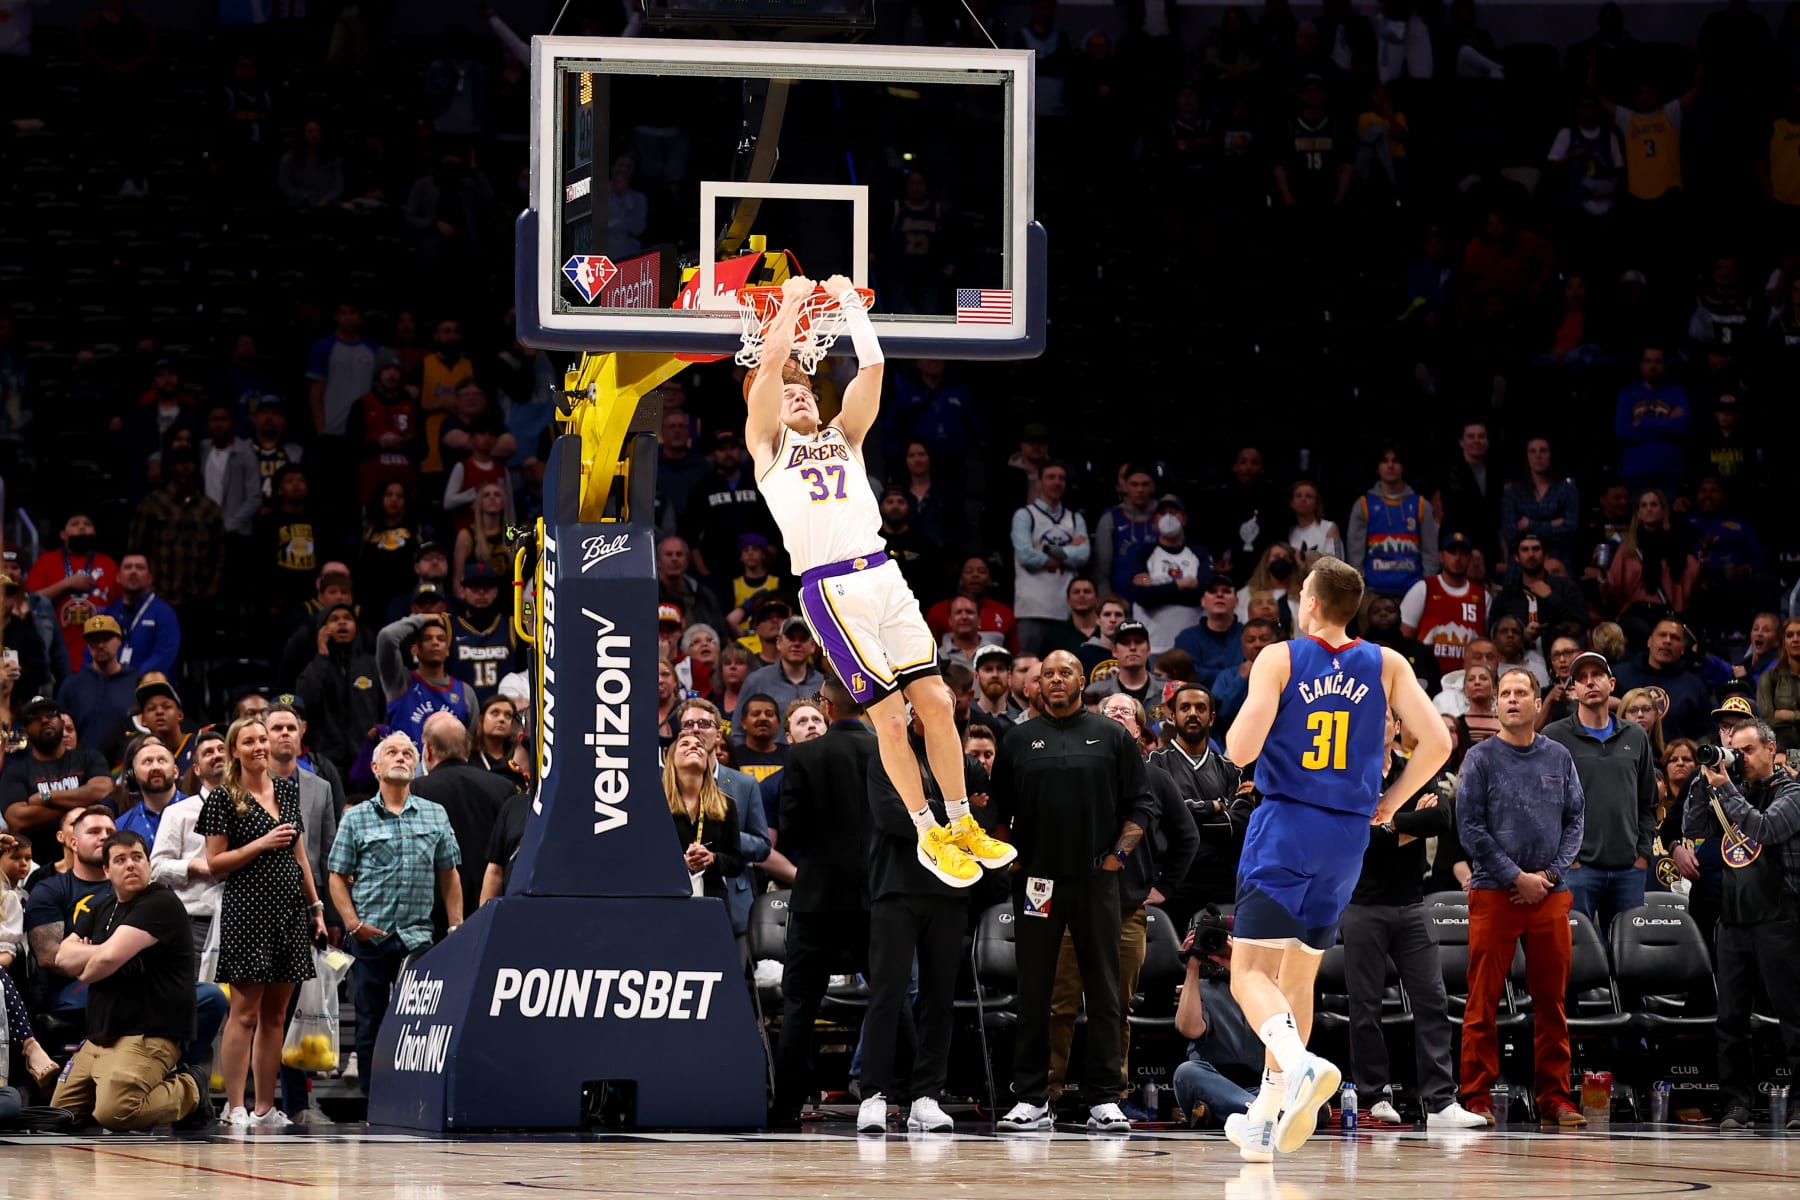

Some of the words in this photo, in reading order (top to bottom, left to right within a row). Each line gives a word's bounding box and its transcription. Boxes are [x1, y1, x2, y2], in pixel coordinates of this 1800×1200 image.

[1642, 139, 1656, 160] 3
[594, 263, 605, 277] 75
[784, 444, 849, 470] LAKERS
[800, 465, 848, 503] 37
[581, 533, 630, 566] Ball
[1461, 602, 1477, 622] 15
[1433, 643, 1465, 657] DENV
[473, 661, 497, 687] 15
[1298, 671, 1369, 705] ČANČAR
[410, 700, 434, 724] MILE
[583, 634, 631, 835] verizon
[1301, 710, 1350, 770] 31
[1645, 917, 1682, 926] LEXUS
[395, 969, 444, 1016] Western
[489, 967, 723, 1021] POINTSBET
[1137, 1066, 1166, 1076] CLUB
[1670, 1066, 1699, 1075] CLUB
[1672, 1082, 1720, 1091] LEXUS
